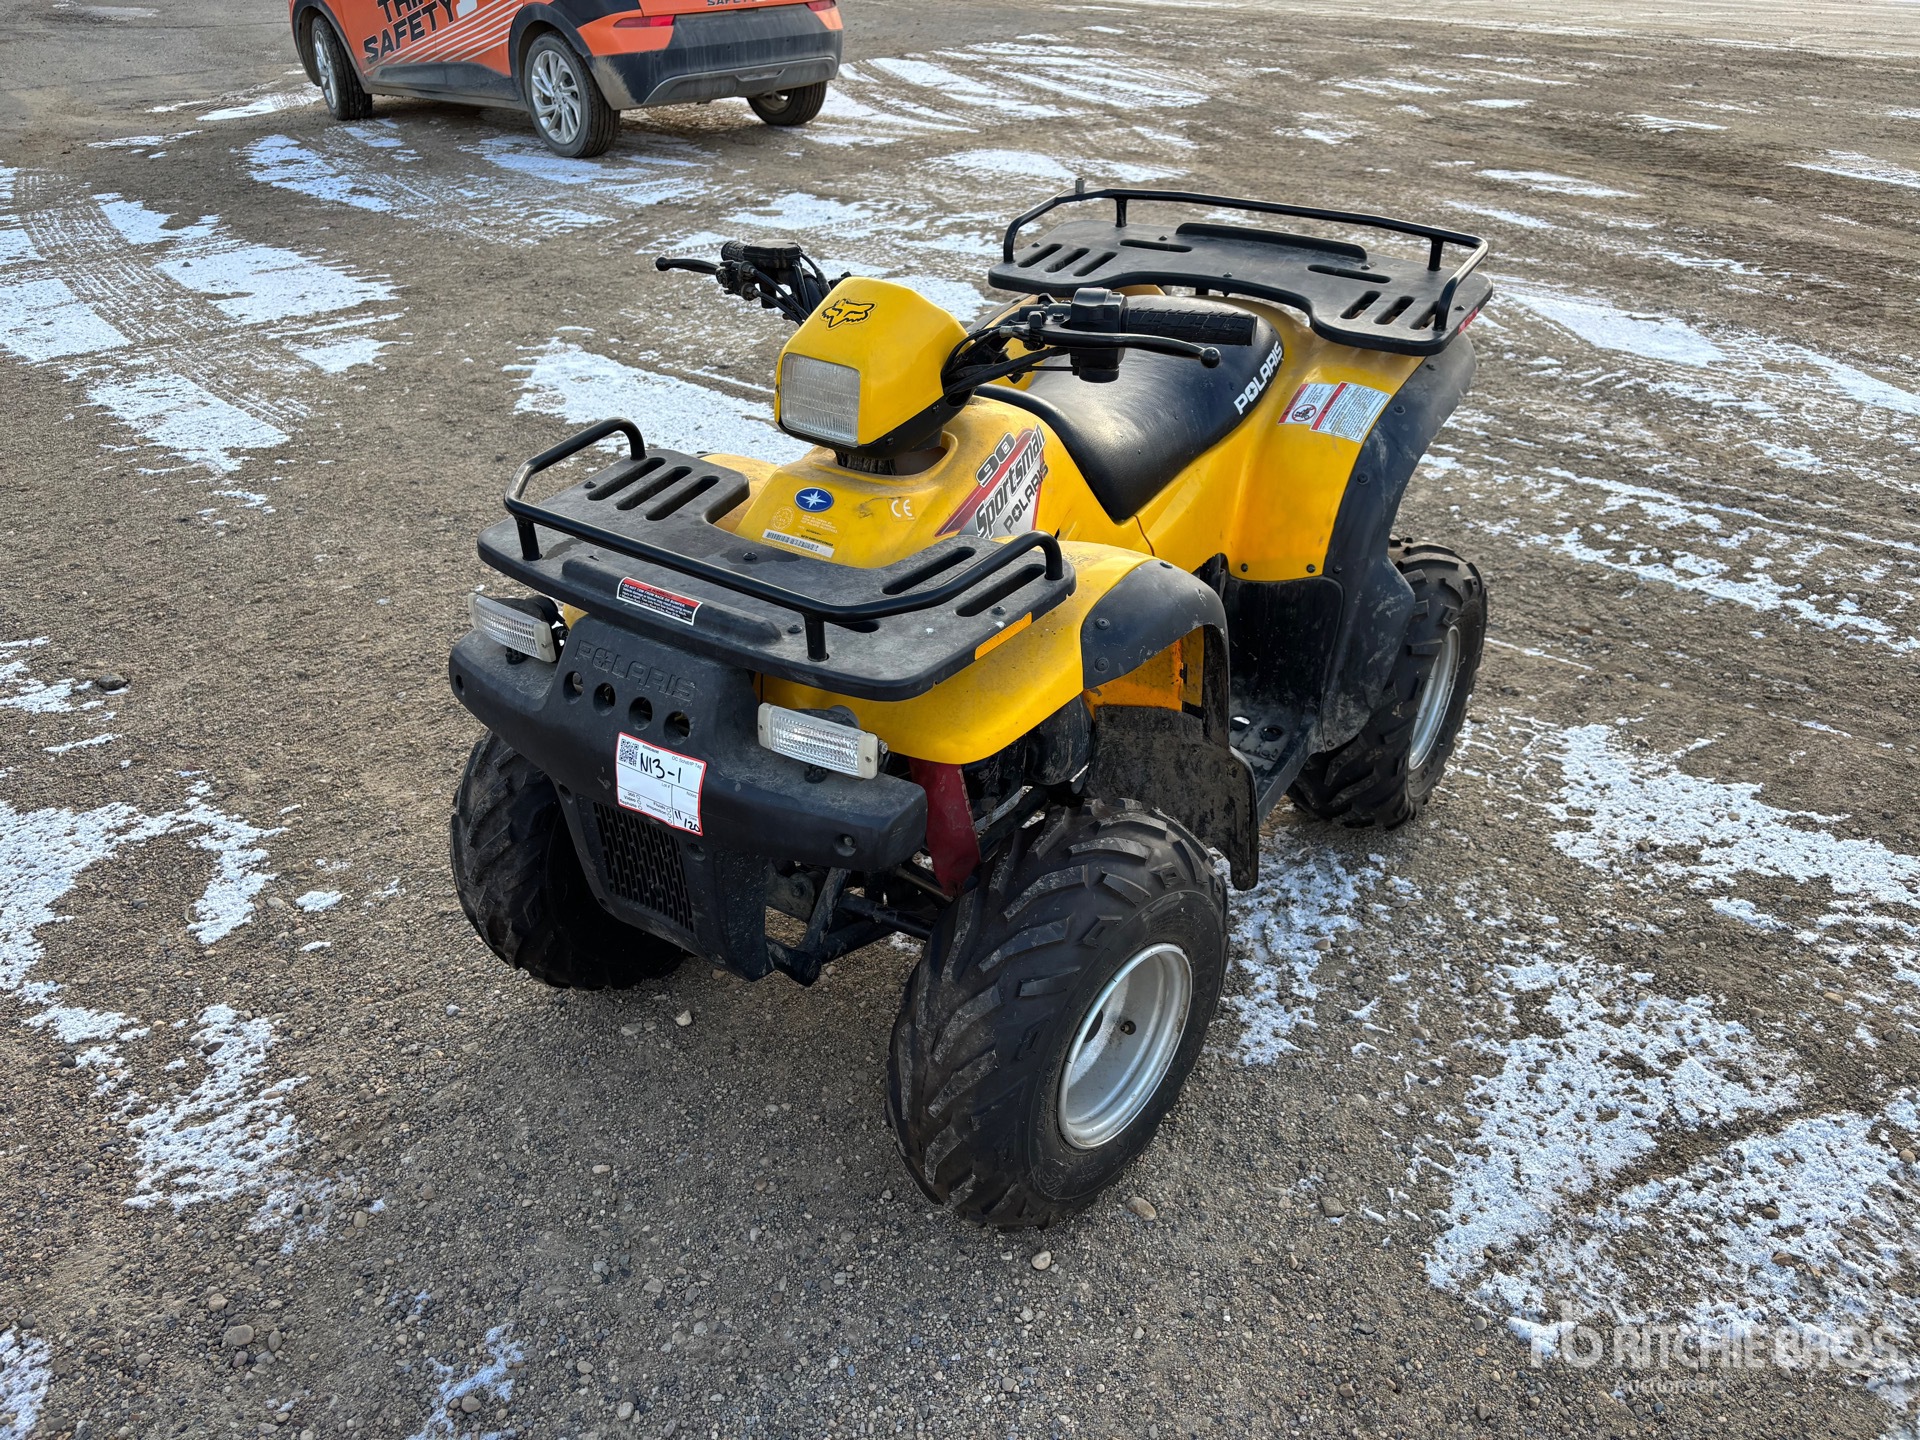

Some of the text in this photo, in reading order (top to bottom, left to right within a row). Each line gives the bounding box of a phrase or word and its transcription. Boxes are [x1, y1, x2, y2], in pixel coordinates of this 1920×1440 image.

[363, 0, 455, 64] SAFETY
[1233, 340, 1283, 415] POLARIS
[976, 433, 1017, 487] 90
[976, 424, 1046, 540] Sportsman
[891, 499, 913, 518] CE
[1003, 461, 1049, 534] POLARIS
[575, 640, 698, 702] POLARIS
